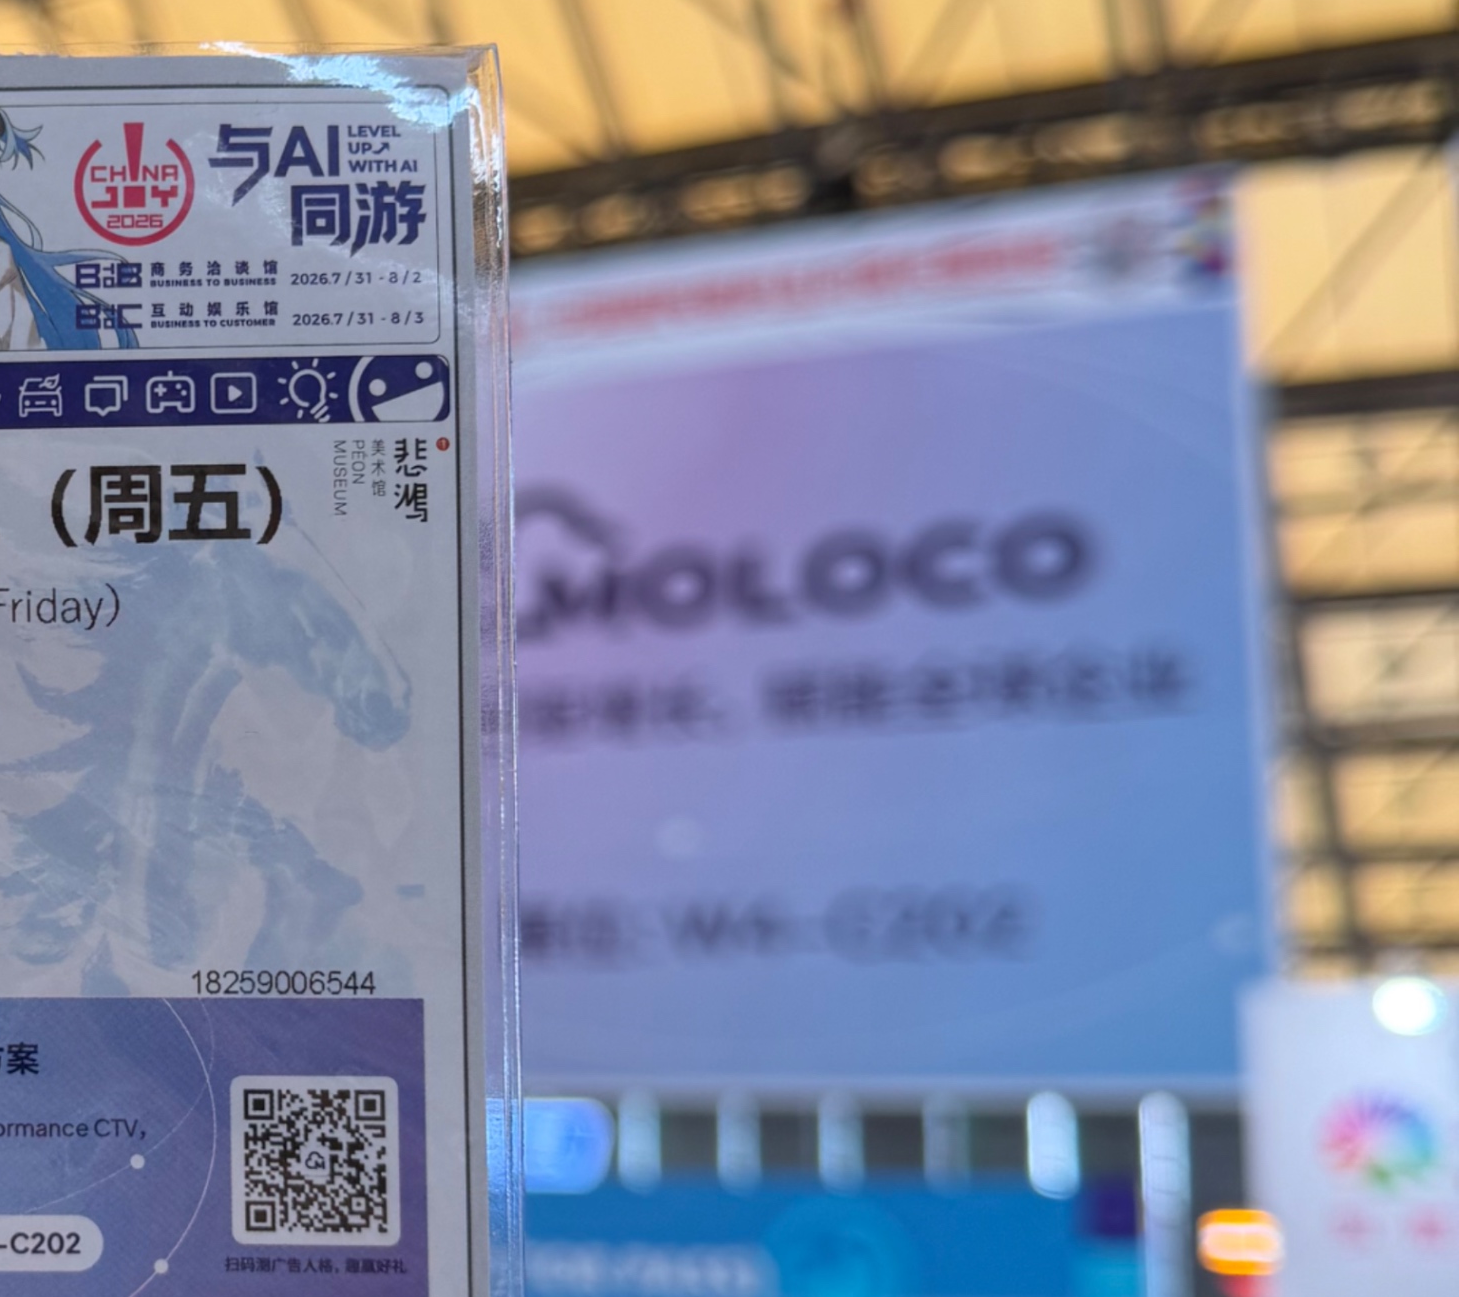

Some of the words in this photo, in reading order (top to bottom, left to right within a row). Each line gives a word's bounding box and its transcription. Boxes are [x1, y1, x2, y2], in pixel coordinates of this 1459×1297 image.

[348, 125, 401, 137] LEVEL
[348, 142, 372, 154] UP
[348, 160, 397, 173] WITH
[401, 160, 418, 172] AI
[107, 214, 163, 229] 2026
[291, 180, 427, 258] 同游
[150, 259, 278, 277] 商务洽谈馆
[150, 278, 203, 288] BUSINESS
[206, 278, 221, 287] TO
[223, 277, 277, 286] BUSINESS
[150, 301, 279, 317] 互动娱乐馆
[150, 320, 201, 329] BUSINESS
[204, 320, 218, 328] TO
[219, 318, 276, 328] CUSTOMER
[371, 439, 386, 497] 美术馆
[333, 440, 348, 516] MUSEUM
[192, 970, 376, 995] 18259006544
